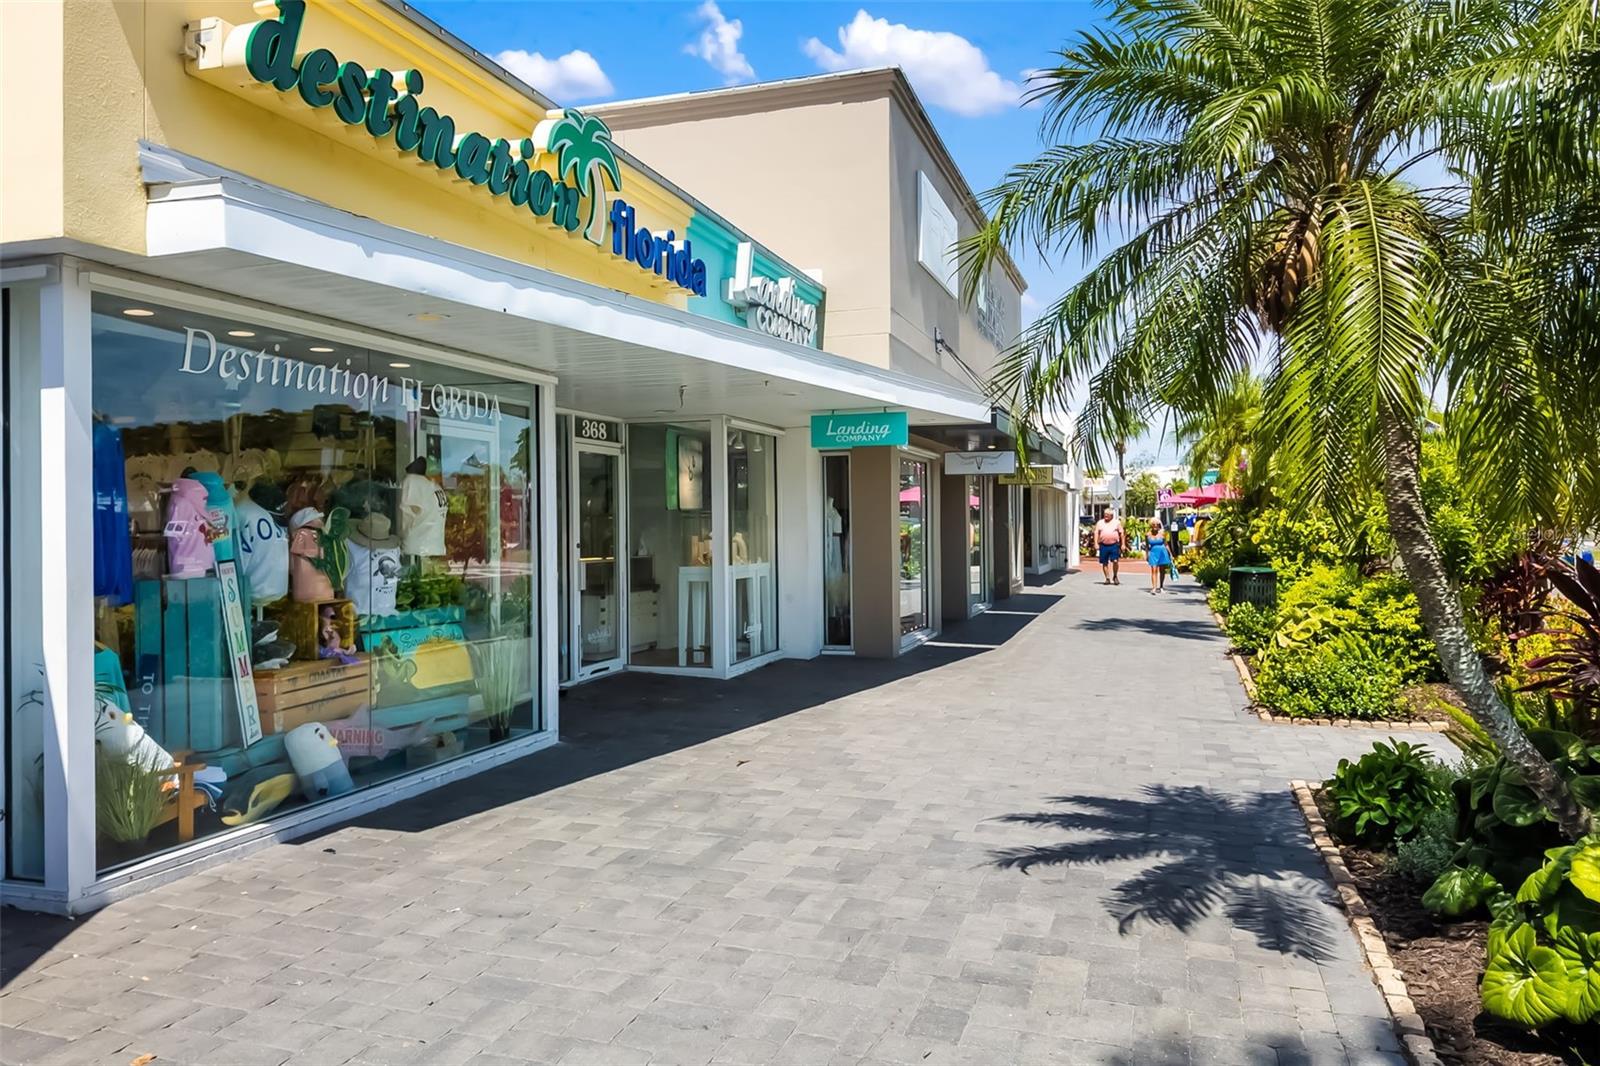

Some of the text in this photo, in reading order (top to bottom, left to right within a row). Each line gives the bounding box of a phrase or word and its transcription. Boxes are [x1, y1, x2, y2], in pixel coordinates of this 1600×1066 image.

[246, 0, 581, 232] destination
[609, 199, 708, 298] florida
[179, 326, 504, 422] Destination FLORIDA
[581, 419, 608, 440] 368
[826, 419, 892, 438] Landing
[835, 434, 882, 443] COMPANY
[141, 673, 155, 695] TO
